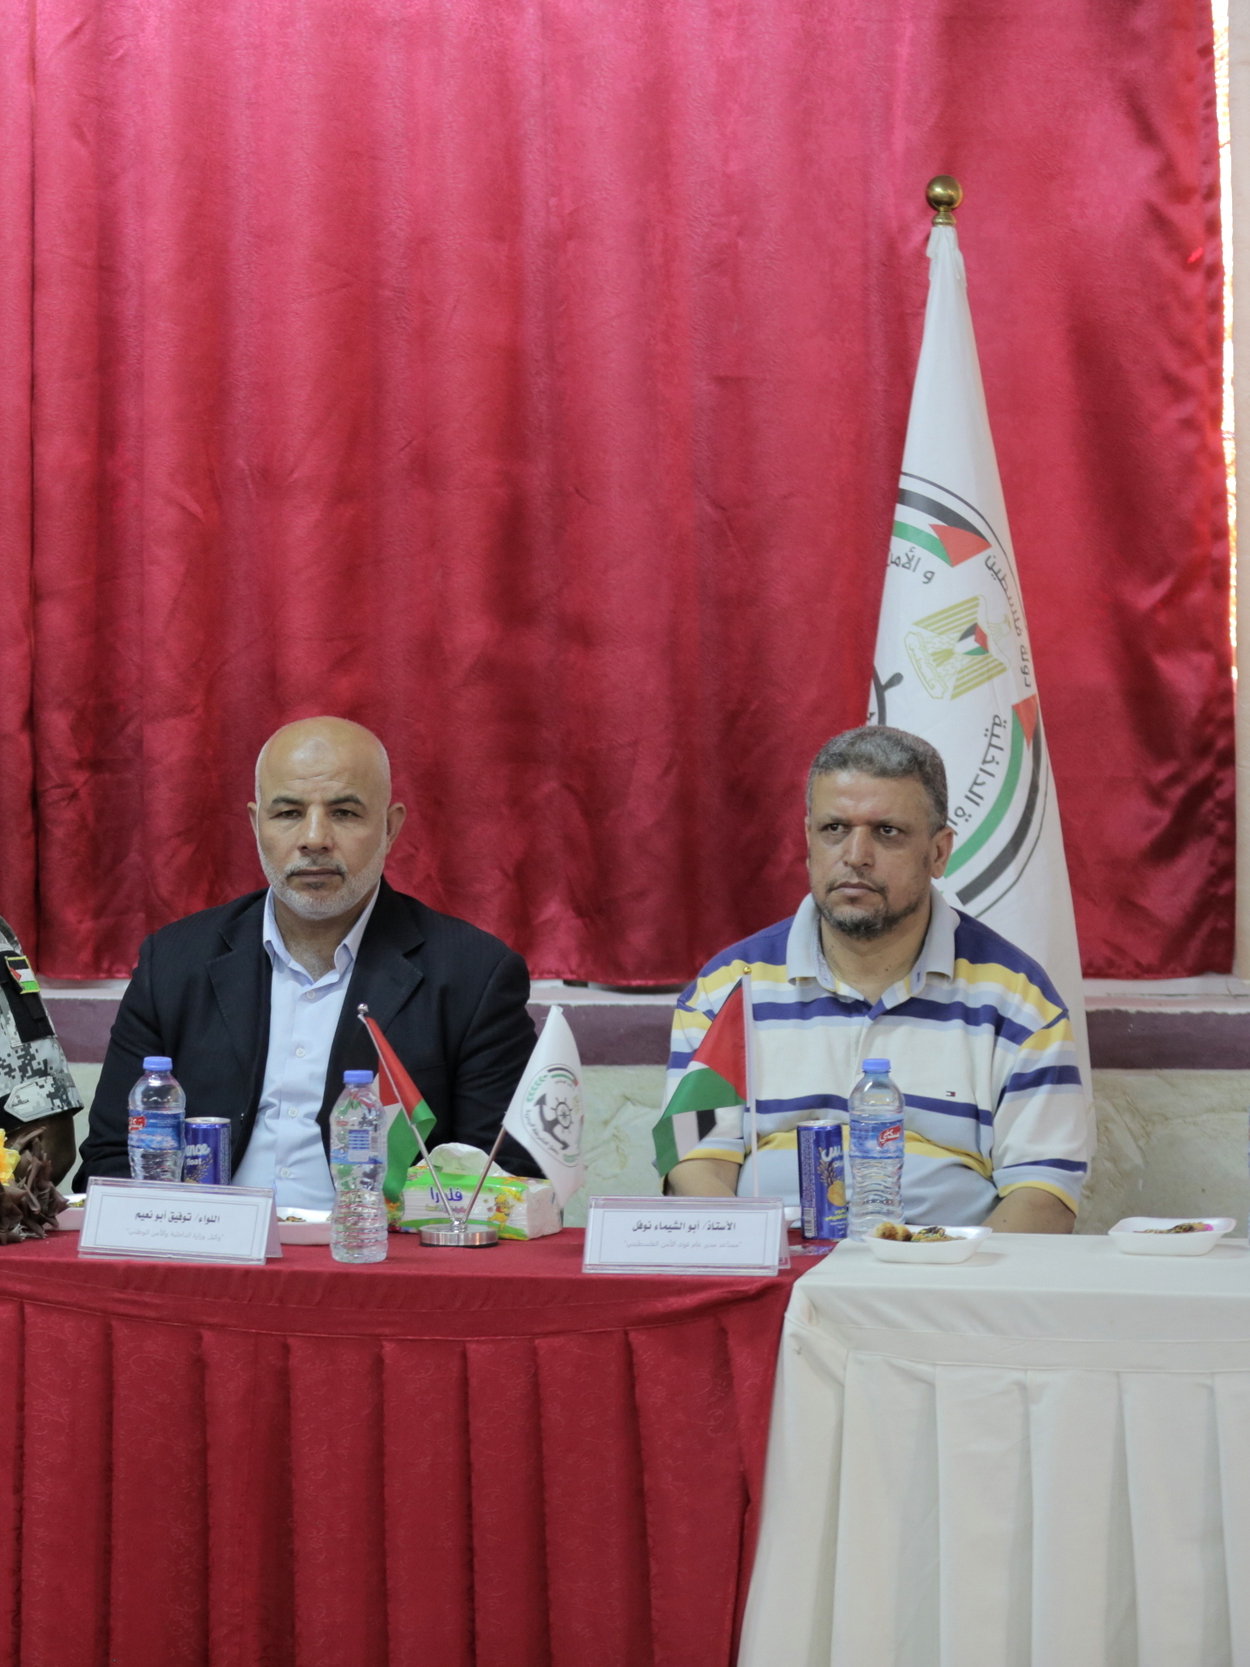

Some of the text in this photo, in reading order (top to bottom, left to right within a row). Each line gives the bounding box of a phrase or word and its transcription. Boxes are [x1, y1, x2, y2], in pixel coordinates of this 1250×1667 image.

[984, 554, 1023, 637] فلسطين
[964, 714, 1008, 807] الداخلية
[430, 1187, 463, 1203] فلرا
[135, 1209, 153, 1221] نعيم
[154, 1210, 167, 1222] أبو
[168, 1211, 192, 1223] توفيق
[632, 1220, 652, 1232] نوفل
[654, 1220, 686, 1232] الشيماء
[687, 1220, 700, 1232] أبو
